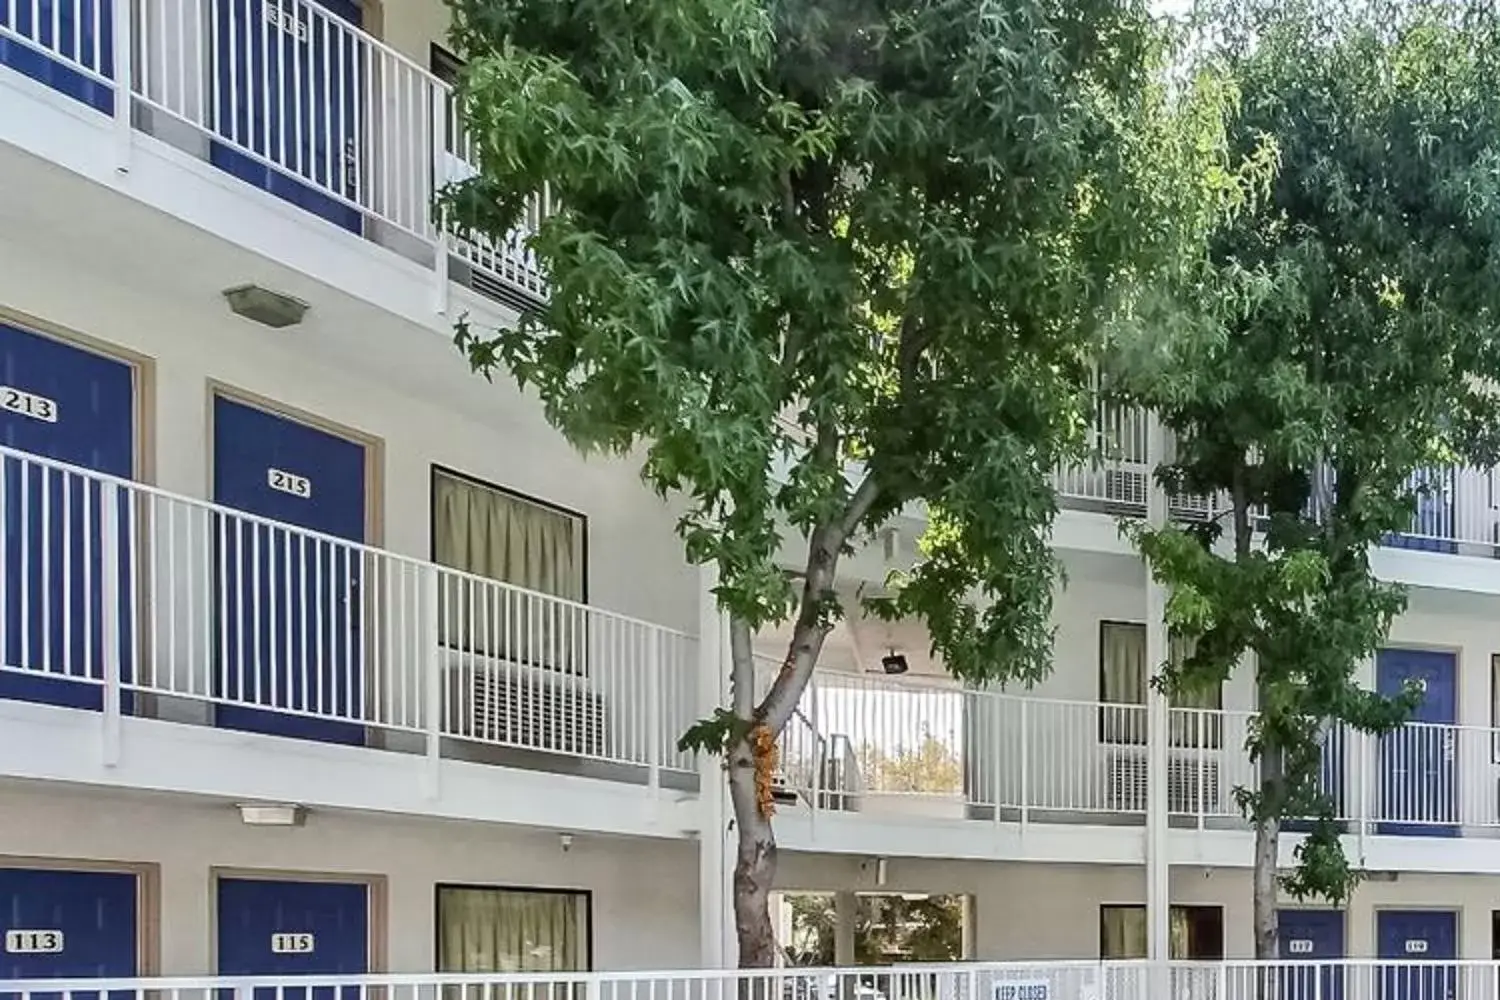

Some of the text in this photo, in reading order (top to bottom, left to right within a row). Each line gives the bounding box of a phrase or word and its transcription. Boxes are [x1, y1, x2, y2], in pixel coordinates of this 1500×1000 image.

[6, 391, 51, 418] 213
[274, 473, 306, 493] 215
[15, 933, 56, 949] 113
[277, 935, 309, 950] 115
[1018, 985, 1047, 1000] CLOSED
